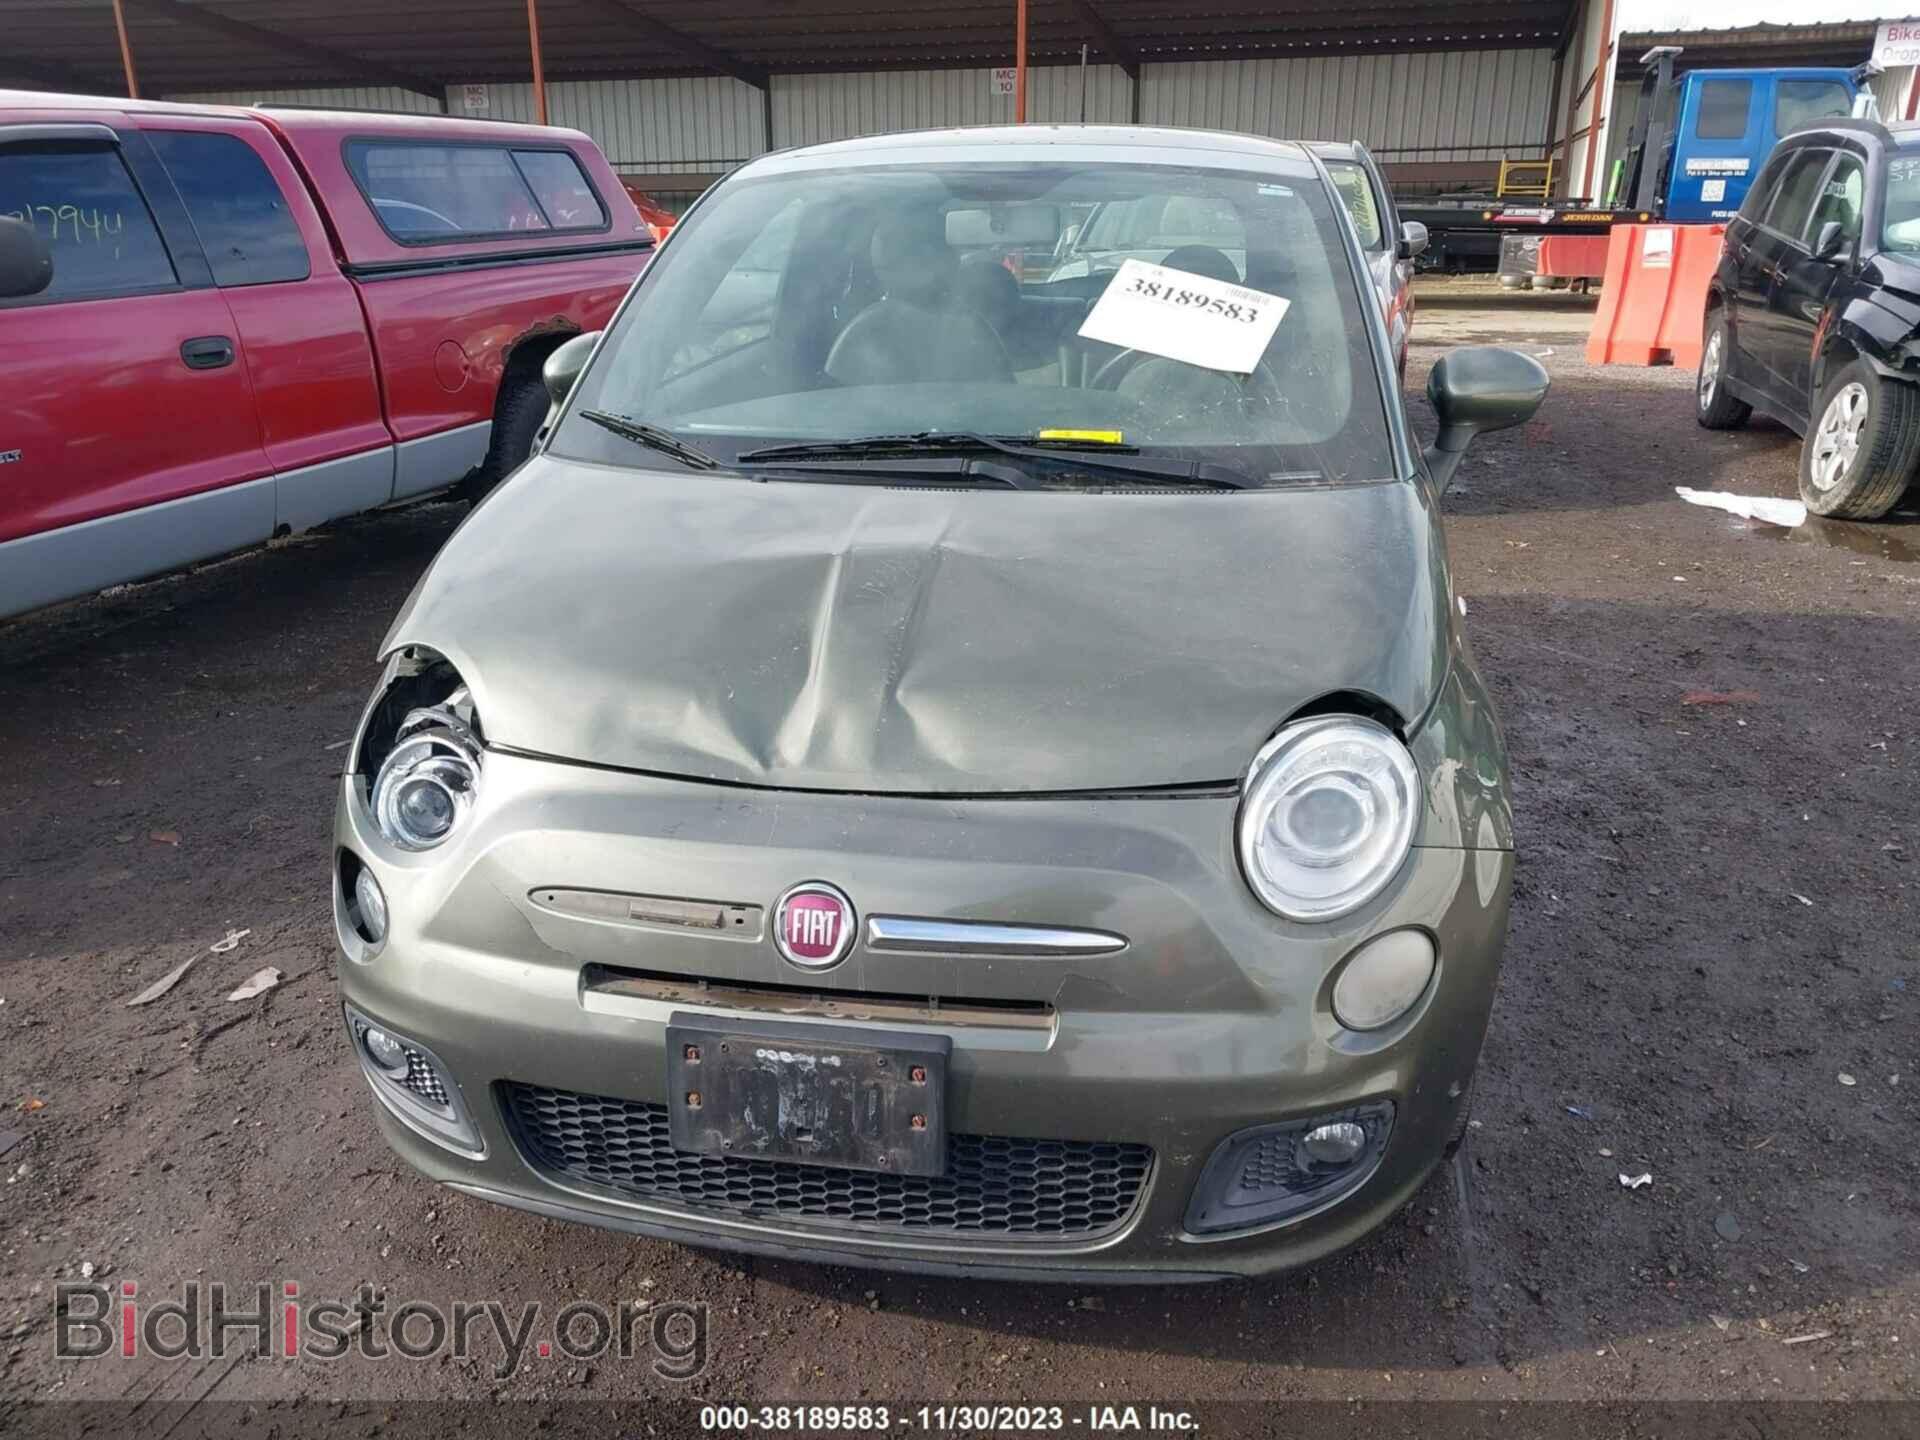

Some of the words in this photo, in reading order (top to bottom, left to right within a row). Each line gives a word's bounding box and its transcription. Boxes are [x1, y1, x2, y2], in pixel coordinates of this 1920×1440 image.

[995, 69, 1017, 80] MC
[1000, 82, 1013, 92] 10
[1126, 277, 1259, 324] 38189583
[792, 908, 838, 947] FIAT
